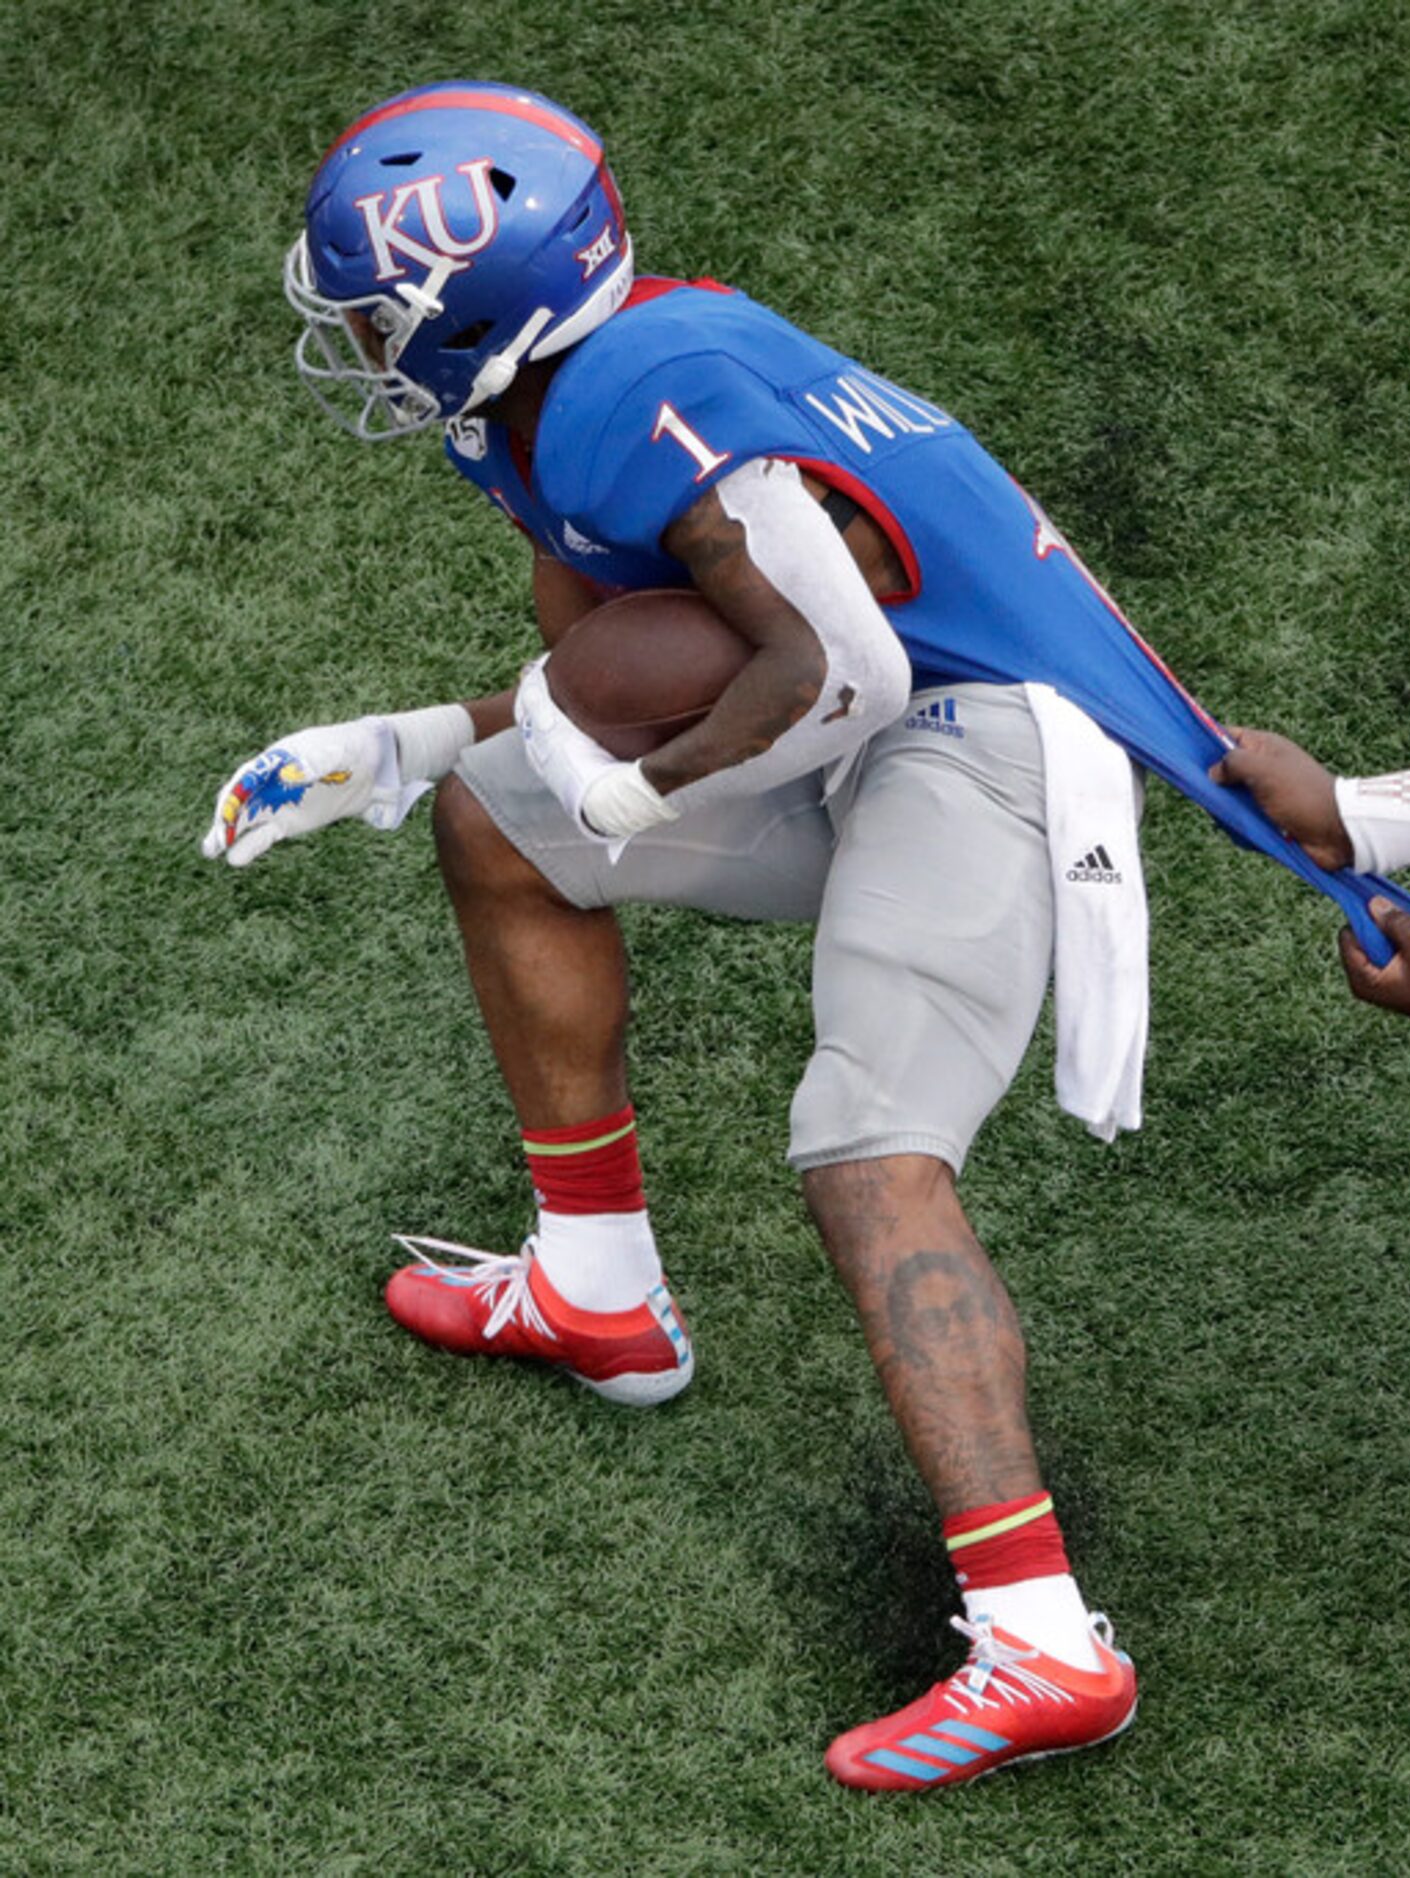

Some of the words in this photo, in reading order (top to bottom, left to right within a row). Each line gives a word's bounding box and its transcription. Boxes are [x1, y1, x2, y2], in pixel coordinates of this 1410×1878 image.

[353, 157, 499, 282] KU
[650, 399, 733, 485] 1
[1065, 868, 1123, 885] adidas
